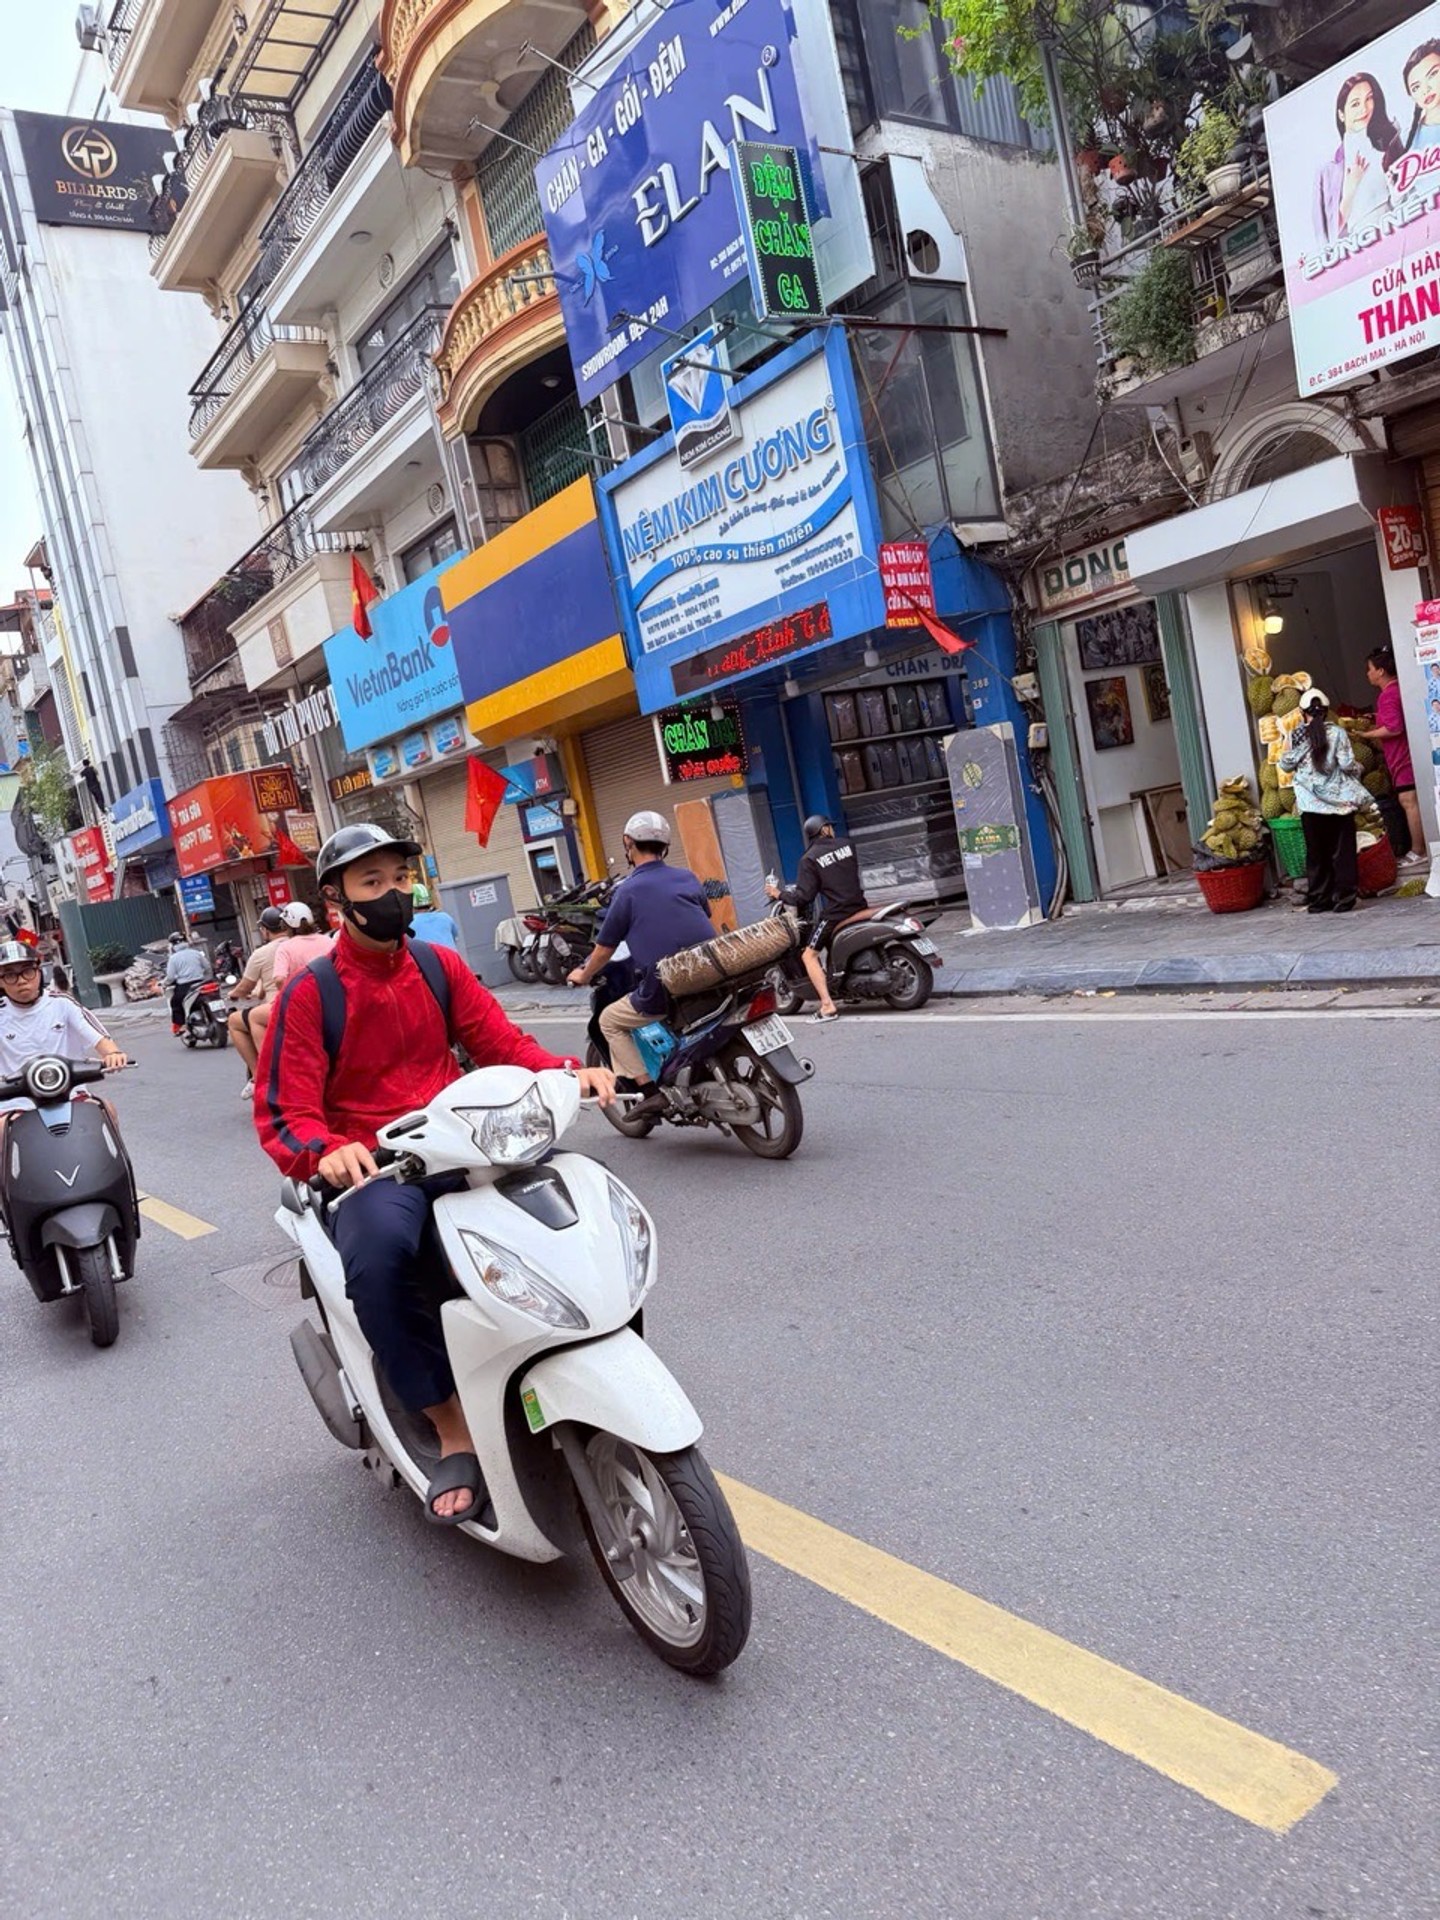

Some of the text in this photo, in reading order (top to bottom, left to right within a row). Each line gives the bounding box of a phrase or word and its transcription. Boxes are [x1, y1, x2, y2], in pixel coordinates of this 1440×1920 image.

[546, 34, 687, 214] CHĂN GA GỐI ĐỆM
[632, 67, 776, 248] ELAN
[751, 153, 796, 208] ĐỆM
[56, 180, 138, 200] BILLIARDS
[756, 211, 813, 258] CHĂN
[777, 273, 809, 309] GA
[1372, 268, 1407, 297] CỬA
[649, 295, 669, 326] 24H
[1369, 347, 1387, 361] MAI
[1394, 335, 1408, 352] HÀ
[622, 408, 833, 561] NỆM KIM CƯƠNG
[671, 521, 813, 569] 100% cao su thiên nhiên
[346, 635, 436, 709] VietinBank
[664, 713, 711, 754] CHĂN
